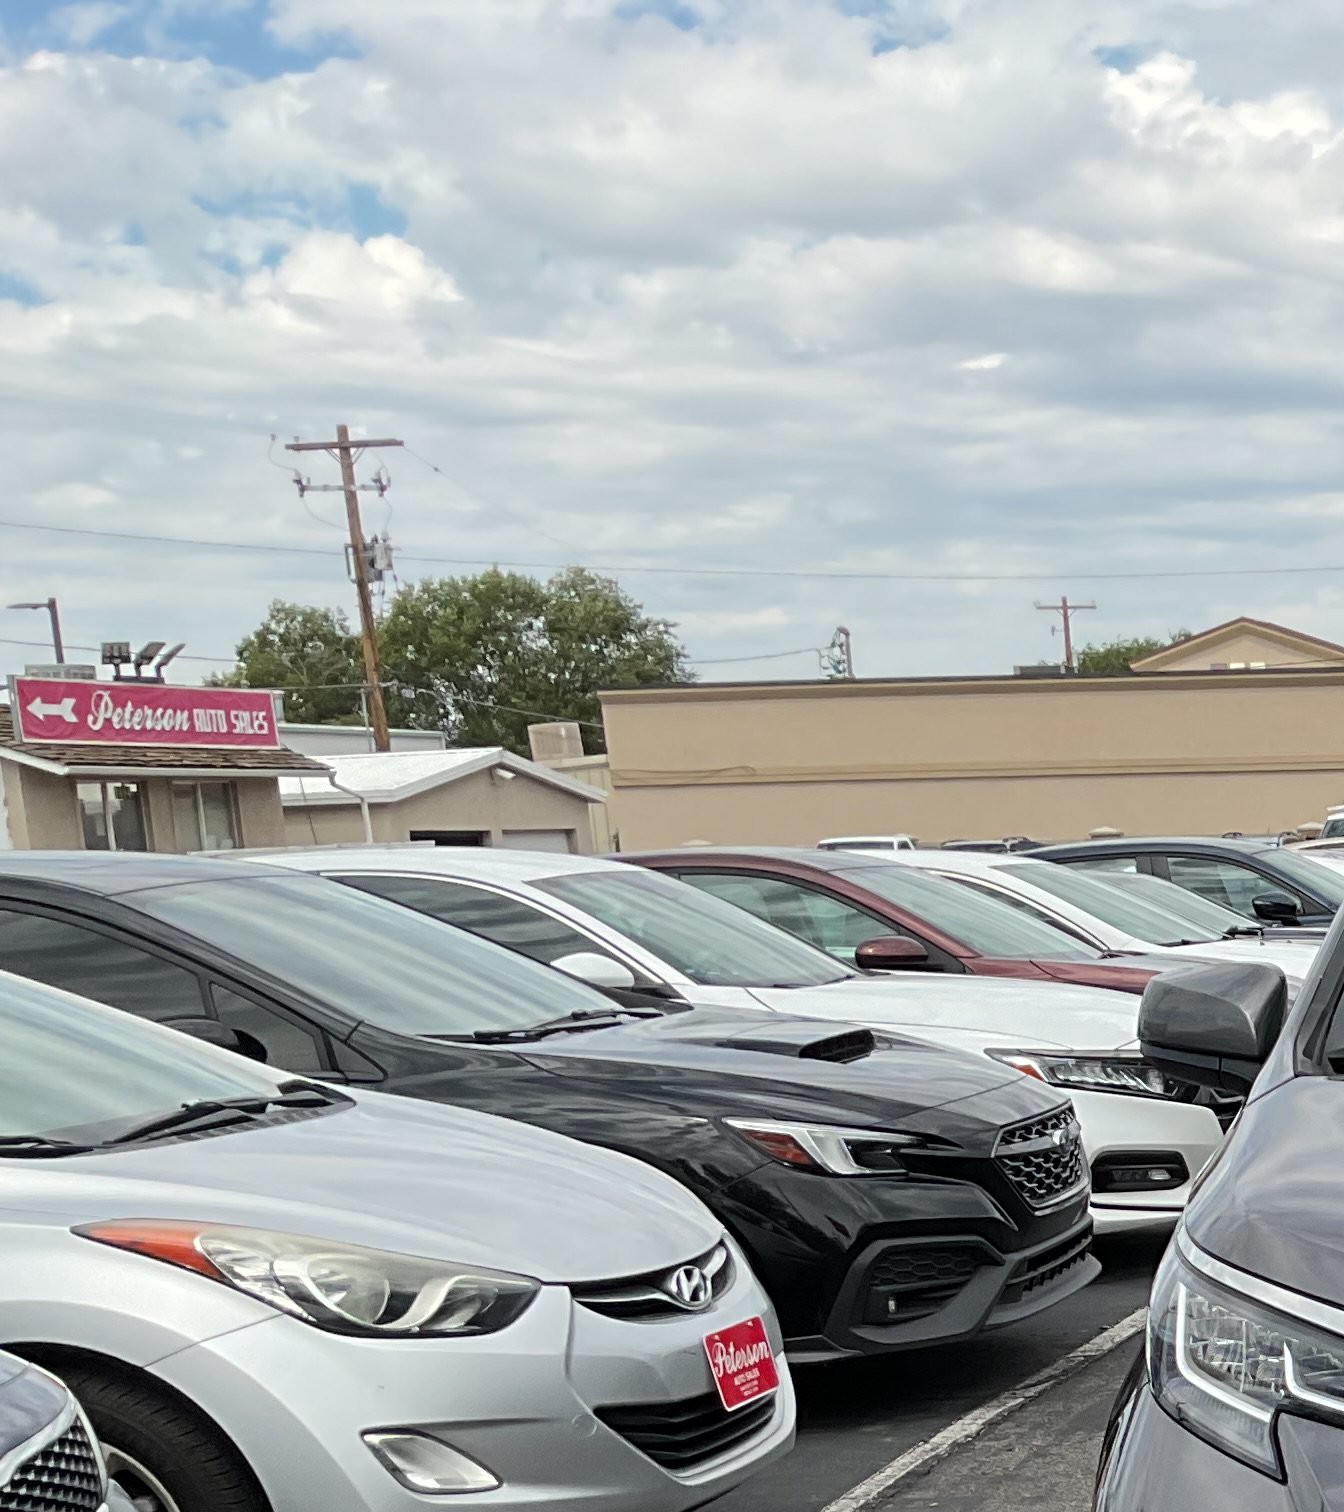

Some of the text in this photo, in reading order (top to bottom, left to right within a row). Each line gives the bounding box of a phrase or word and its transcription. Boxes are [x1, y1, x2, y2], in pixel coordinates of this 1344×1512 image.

[87, 690, 269, 735] Peterson AUTO SALES
[711, 1341, 769, 1378] Peterson
